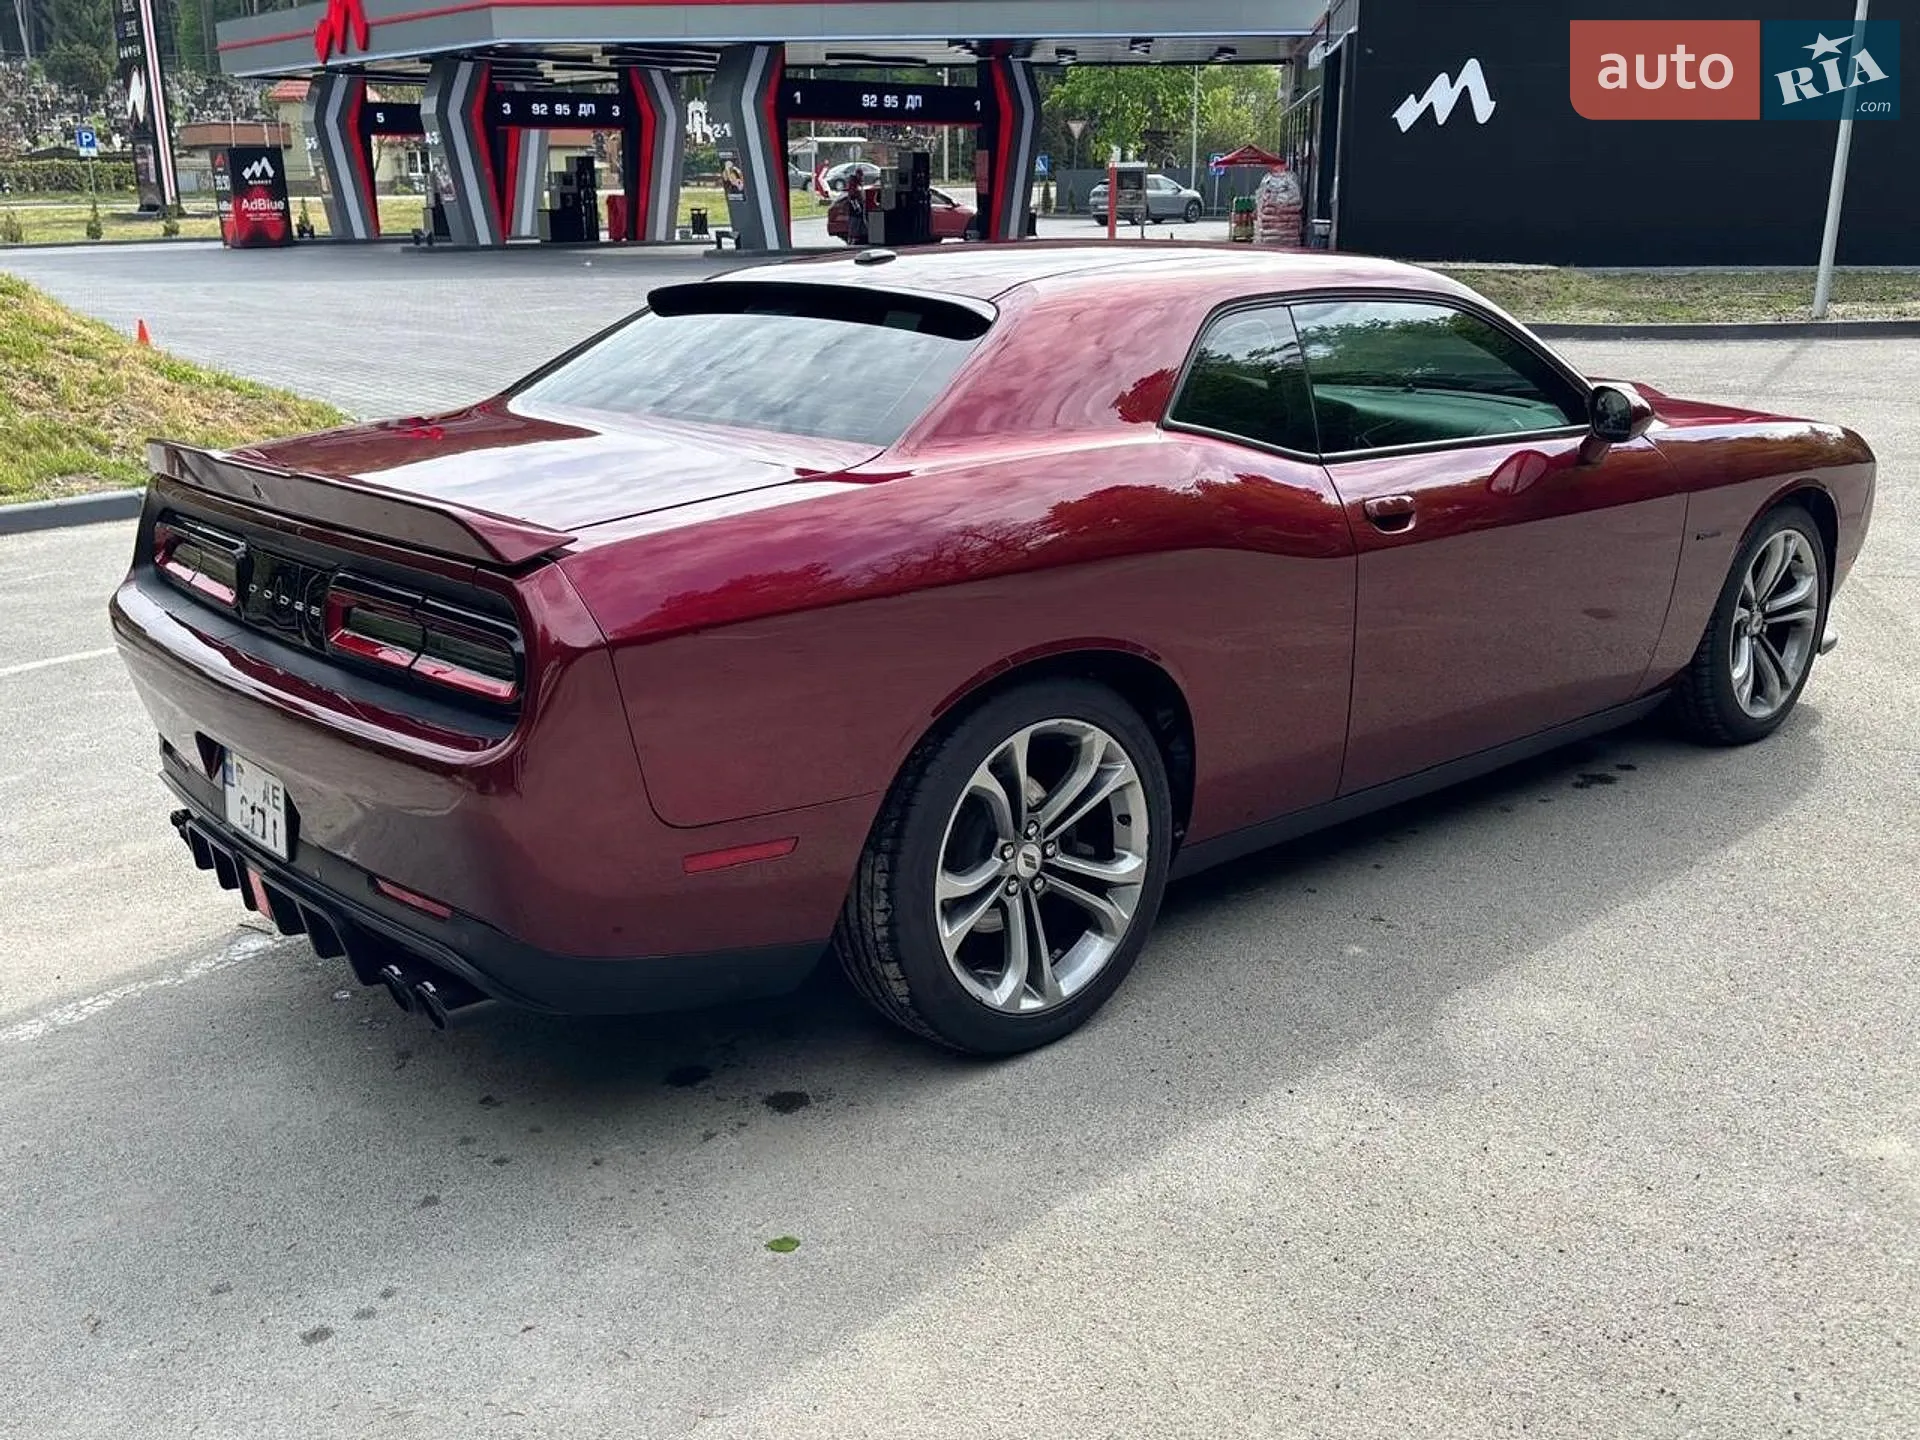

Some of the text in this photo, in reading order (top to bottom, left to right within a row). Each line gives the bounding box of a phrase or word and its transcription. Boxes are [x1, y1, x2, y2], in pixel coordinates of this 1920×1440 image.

[861, 94, 878, 108] 92
[883, 95, 899, 109] 95
[502, 102, 512, 115] 3
[531, 103, 548, 116] 92
[554, 103, 571, 116] 95
[612, 105, 621, 117] 3
[375, 112, 385, 123] 5
[82, 131, 93, 147] P
[241, 198, 285, 211] AdBlue
